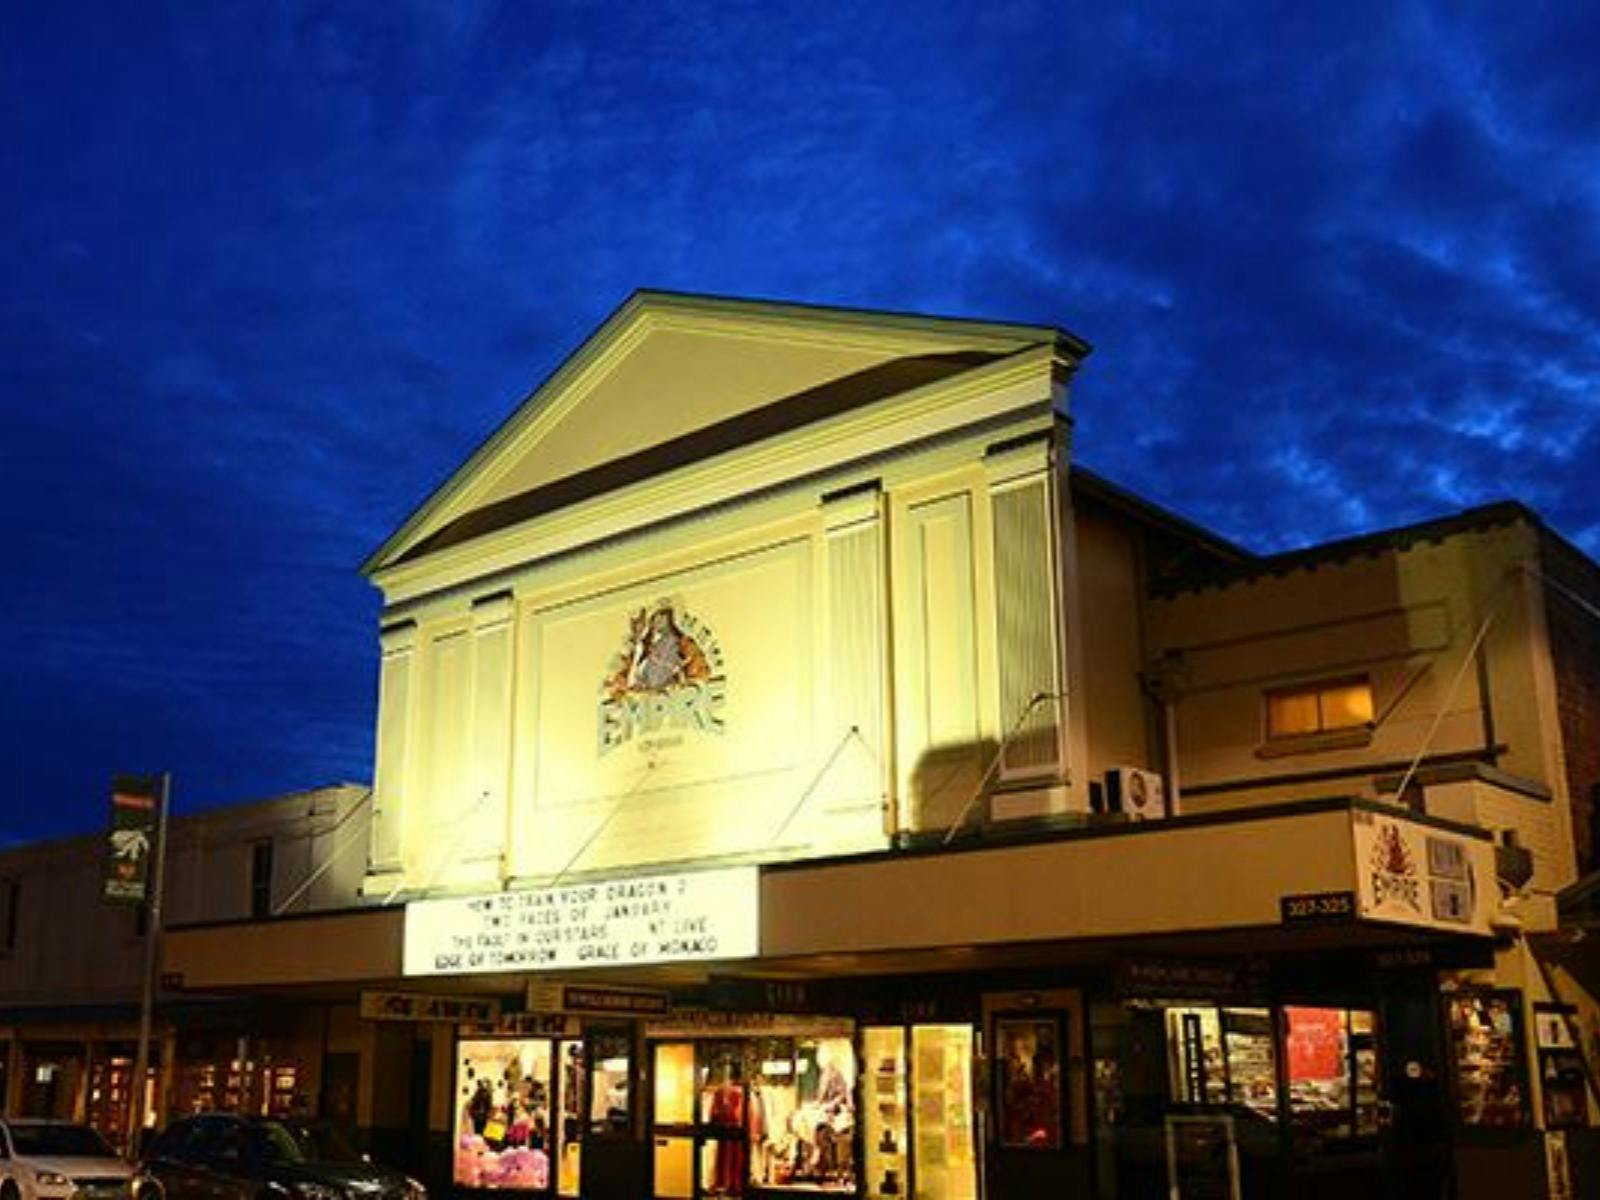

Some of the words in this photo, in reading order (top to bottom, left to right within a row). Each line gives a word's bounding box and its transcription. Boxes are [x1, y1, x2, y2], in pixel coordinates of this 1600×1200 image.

[606, 880, 667, 901] DRAGON
[570, 905, 588, 922] OF
[605, 898, 671, 921] JANUARY
[564, 922, 607, 941] STARS
[576, 942, 619, 961] GRACE
[630, 940, 648, 958] OF
[657, 935, 719, 955] MONACO
